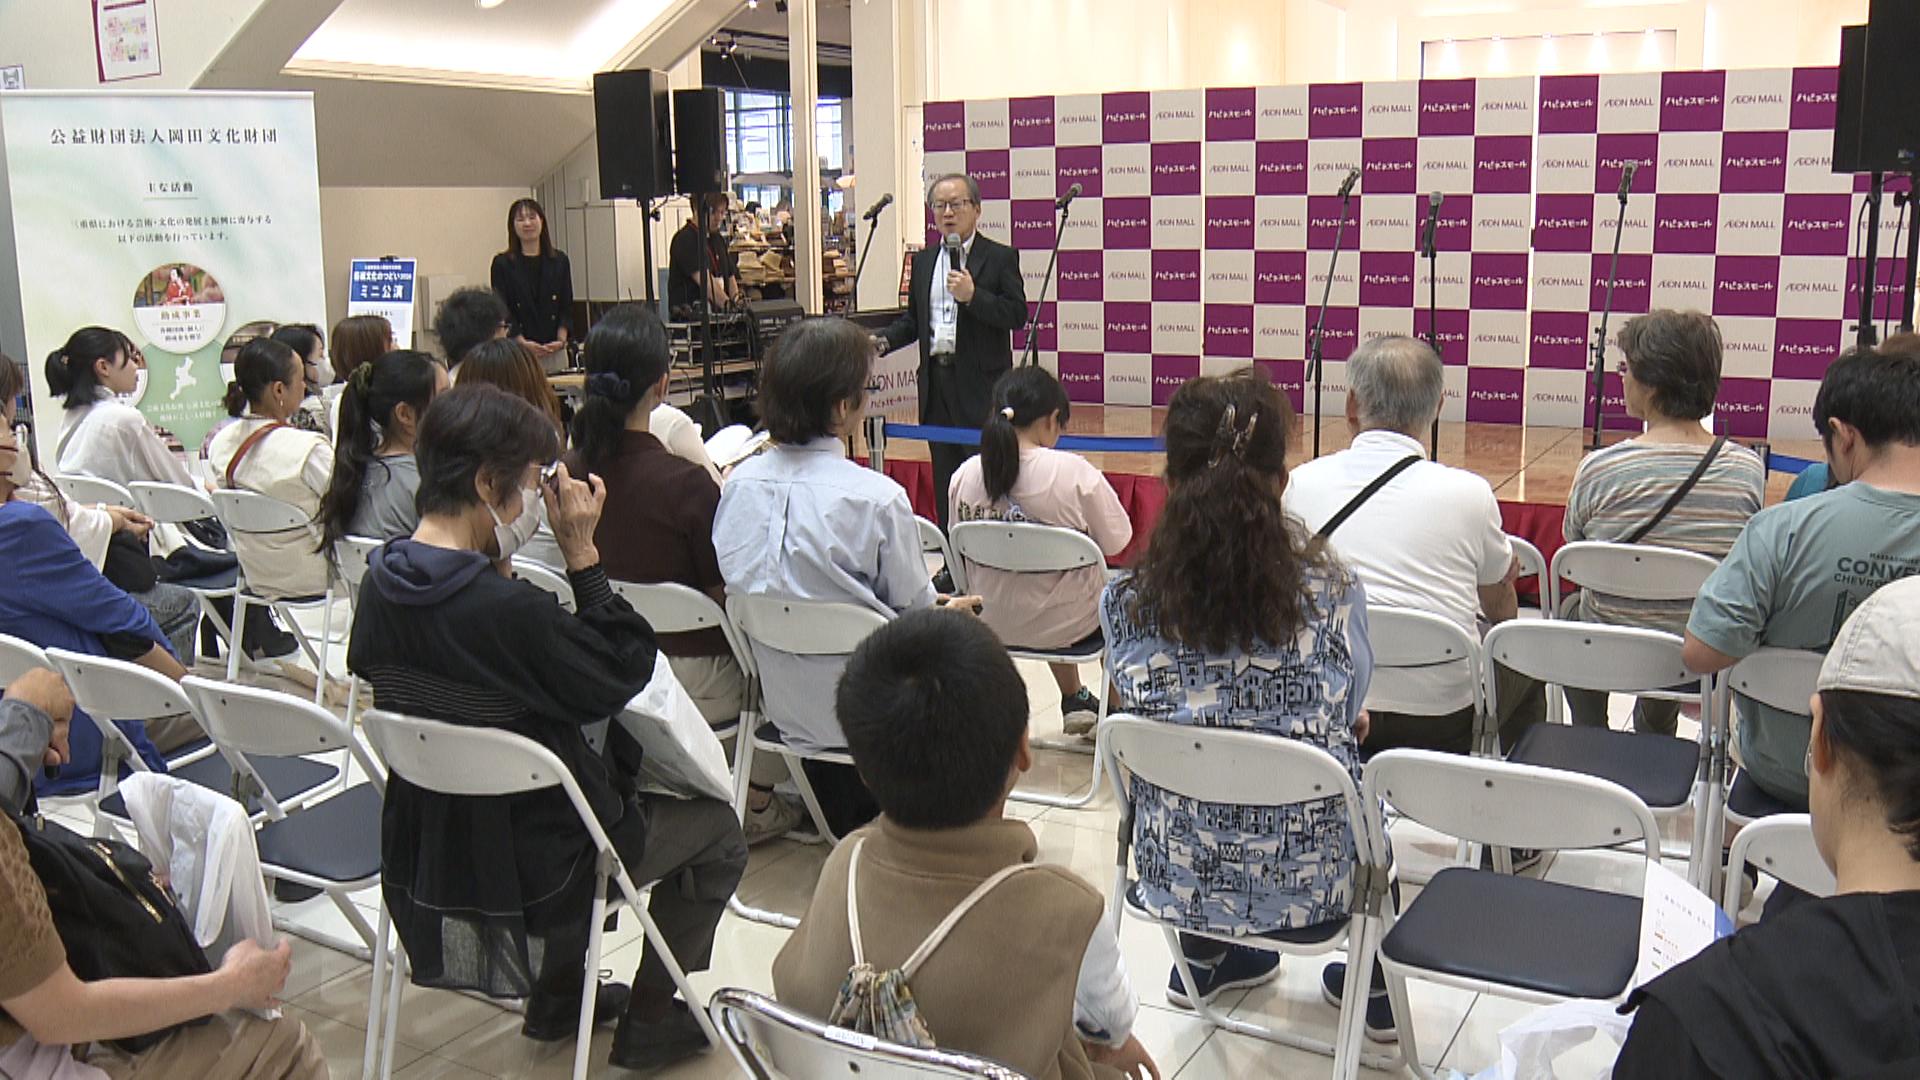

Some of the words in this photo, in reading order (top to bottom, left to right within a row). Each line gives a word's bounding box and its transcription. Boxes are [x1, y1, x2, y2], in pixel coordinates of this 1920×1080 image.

[50, 128, 278, 145] 公益財団法人岡田文化財団
[148, 182, 194, 193] 主な活動
[360, 284, 404, 299] ミニ公演
